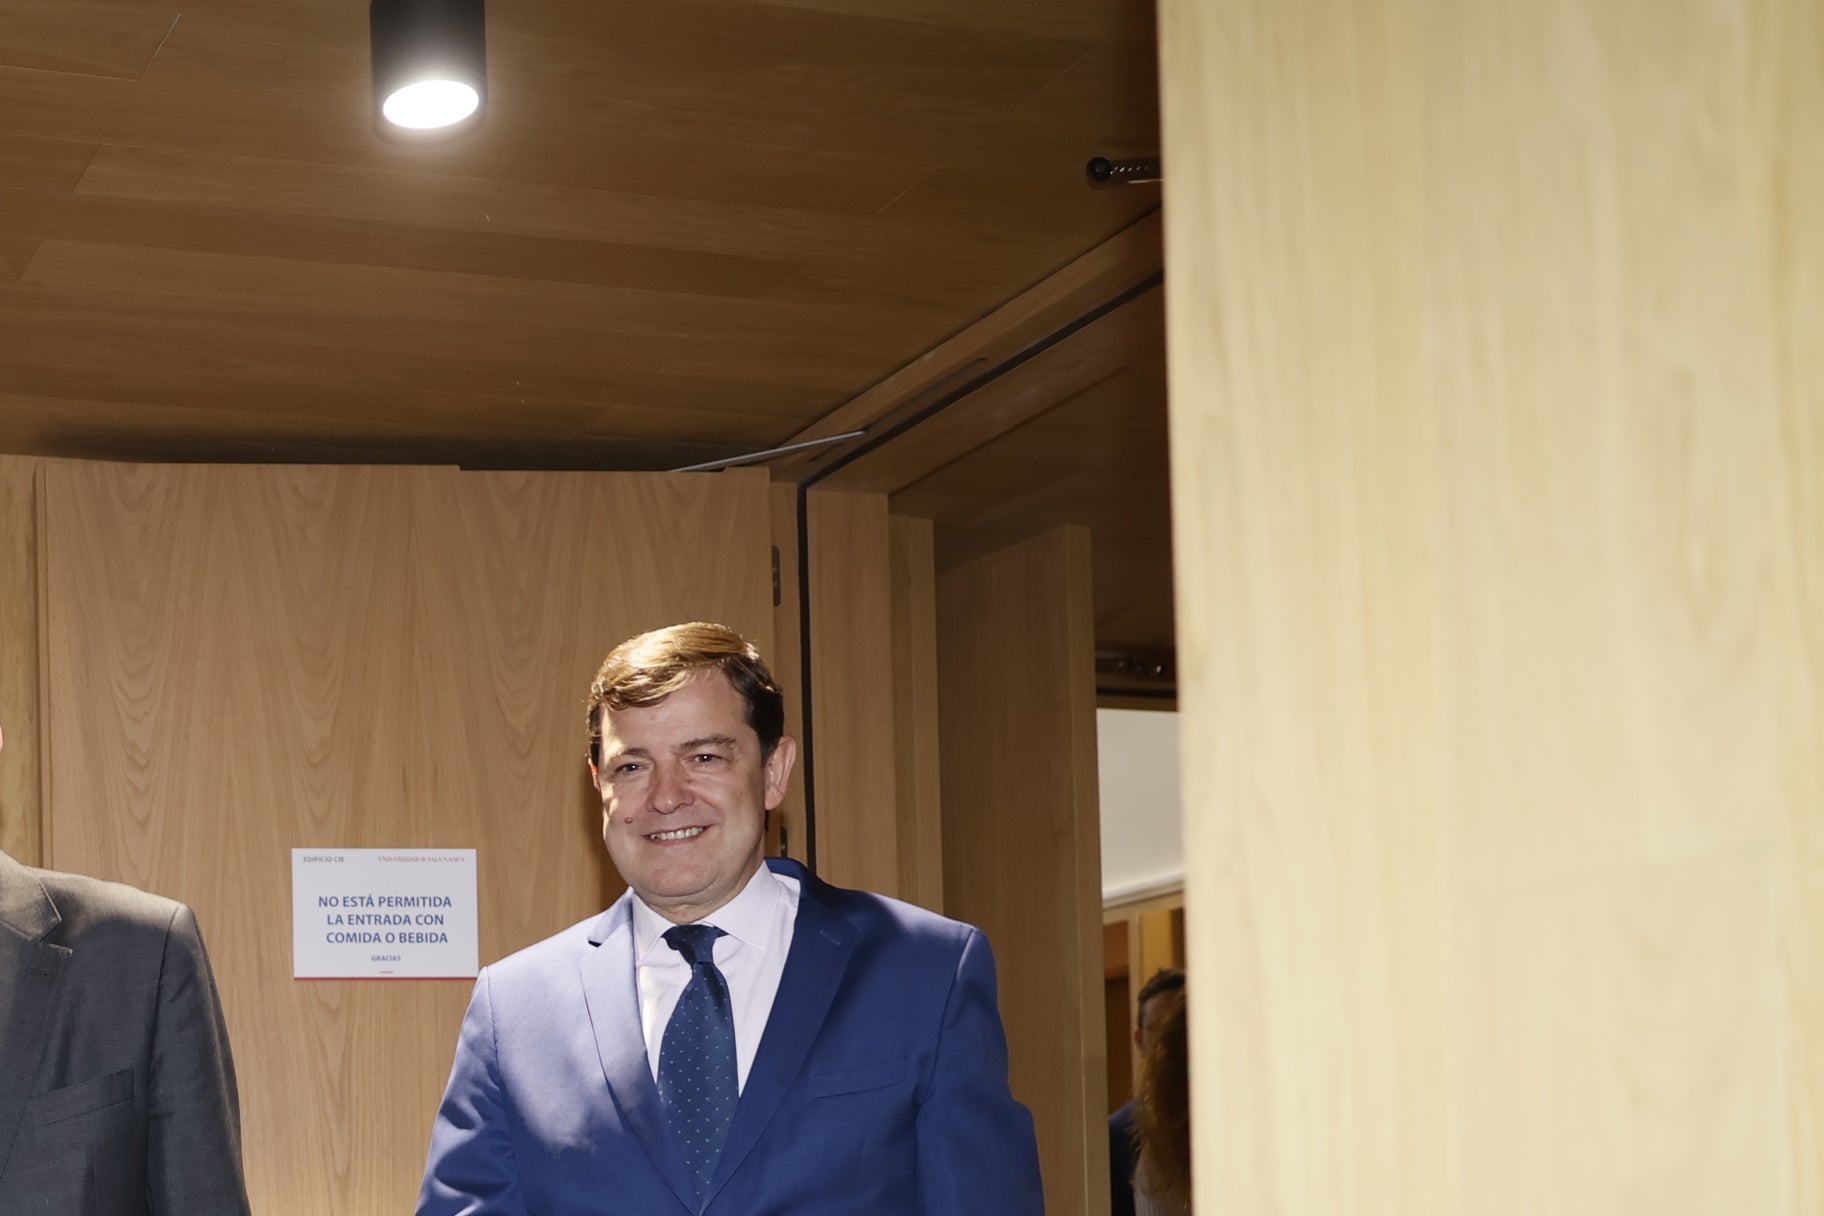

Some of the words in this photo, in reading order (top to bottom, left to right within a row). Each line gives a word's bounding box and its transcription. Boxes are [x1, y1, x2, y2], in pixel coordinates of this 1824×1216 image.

[318, 895, 339, 907] NO
[342, 894, 374, 907] ESTÁ
[378, 896, 452, 907] PERMITIDA
[327, 914, 343, 925] LA
[347, 913, 411, 925] ENTRADA
[415, 913, 444, 925] CON
[326, 931, 381, 943] COMIDA
[384, 931, 395, 943] O
[398, 932, 448, 943] BEBIDA
